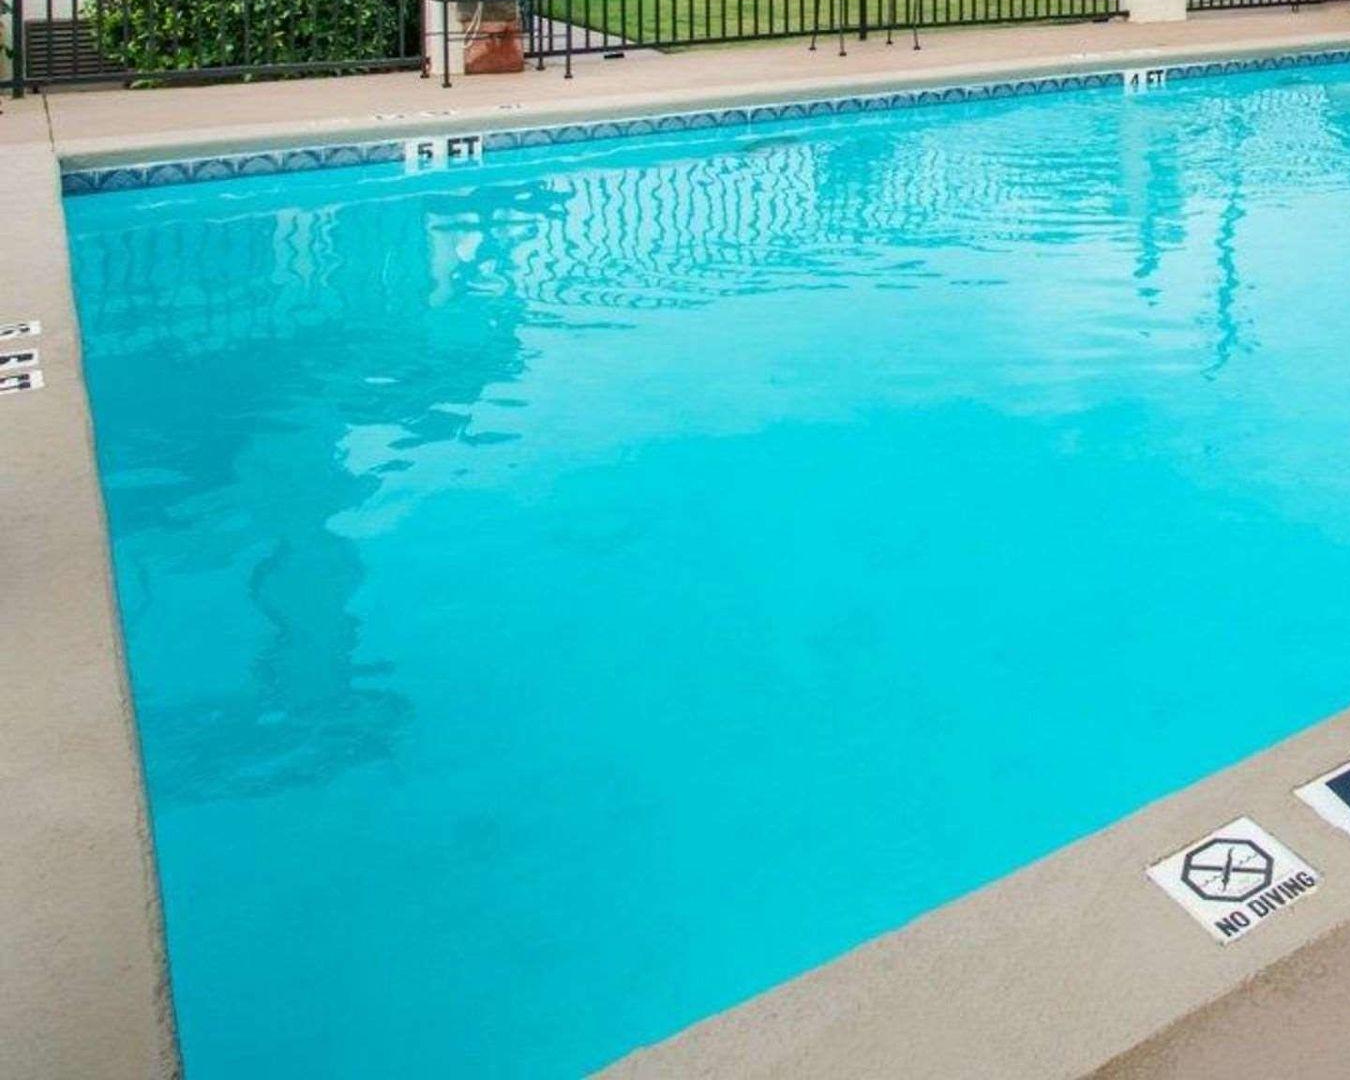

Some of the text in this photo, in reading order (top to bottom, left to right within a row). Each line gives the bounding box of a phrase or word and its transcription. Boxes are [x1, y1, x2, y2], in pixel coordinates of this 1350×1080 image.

[417, 142, 433, 159] 5
[1214, 871, 1315, 937] NO DIVING
